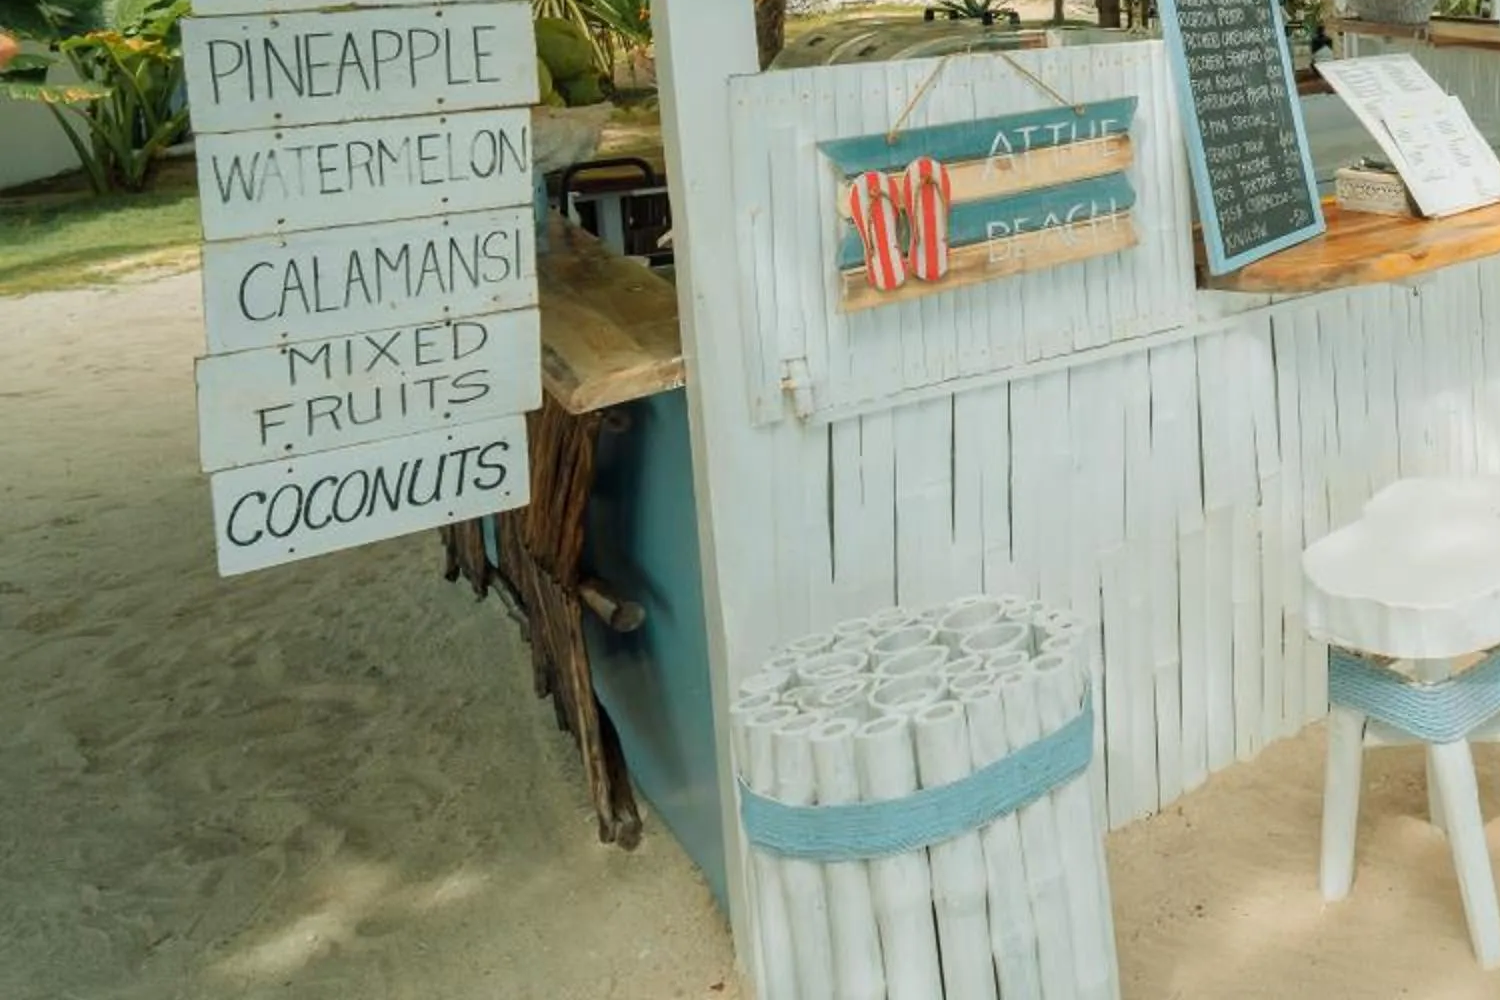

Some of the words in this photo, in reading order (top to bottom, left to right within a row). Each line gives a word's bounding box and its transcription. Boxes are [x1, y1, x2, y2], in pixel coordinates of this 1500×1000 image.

[206, 25, 501, 105] PINEAPPLE
[211, 125, 528, 204] WATERMELON
[983, 124, 1037, 181] AT
[985, 195, 1119, 264] BEACH
[238, 228, 522, 322] CALAMANSI
[286, 321, 489, 386] MIXED
[254, 369, 490, 446] FRUITS
[226, 441, 511, 547] COCONUTS
